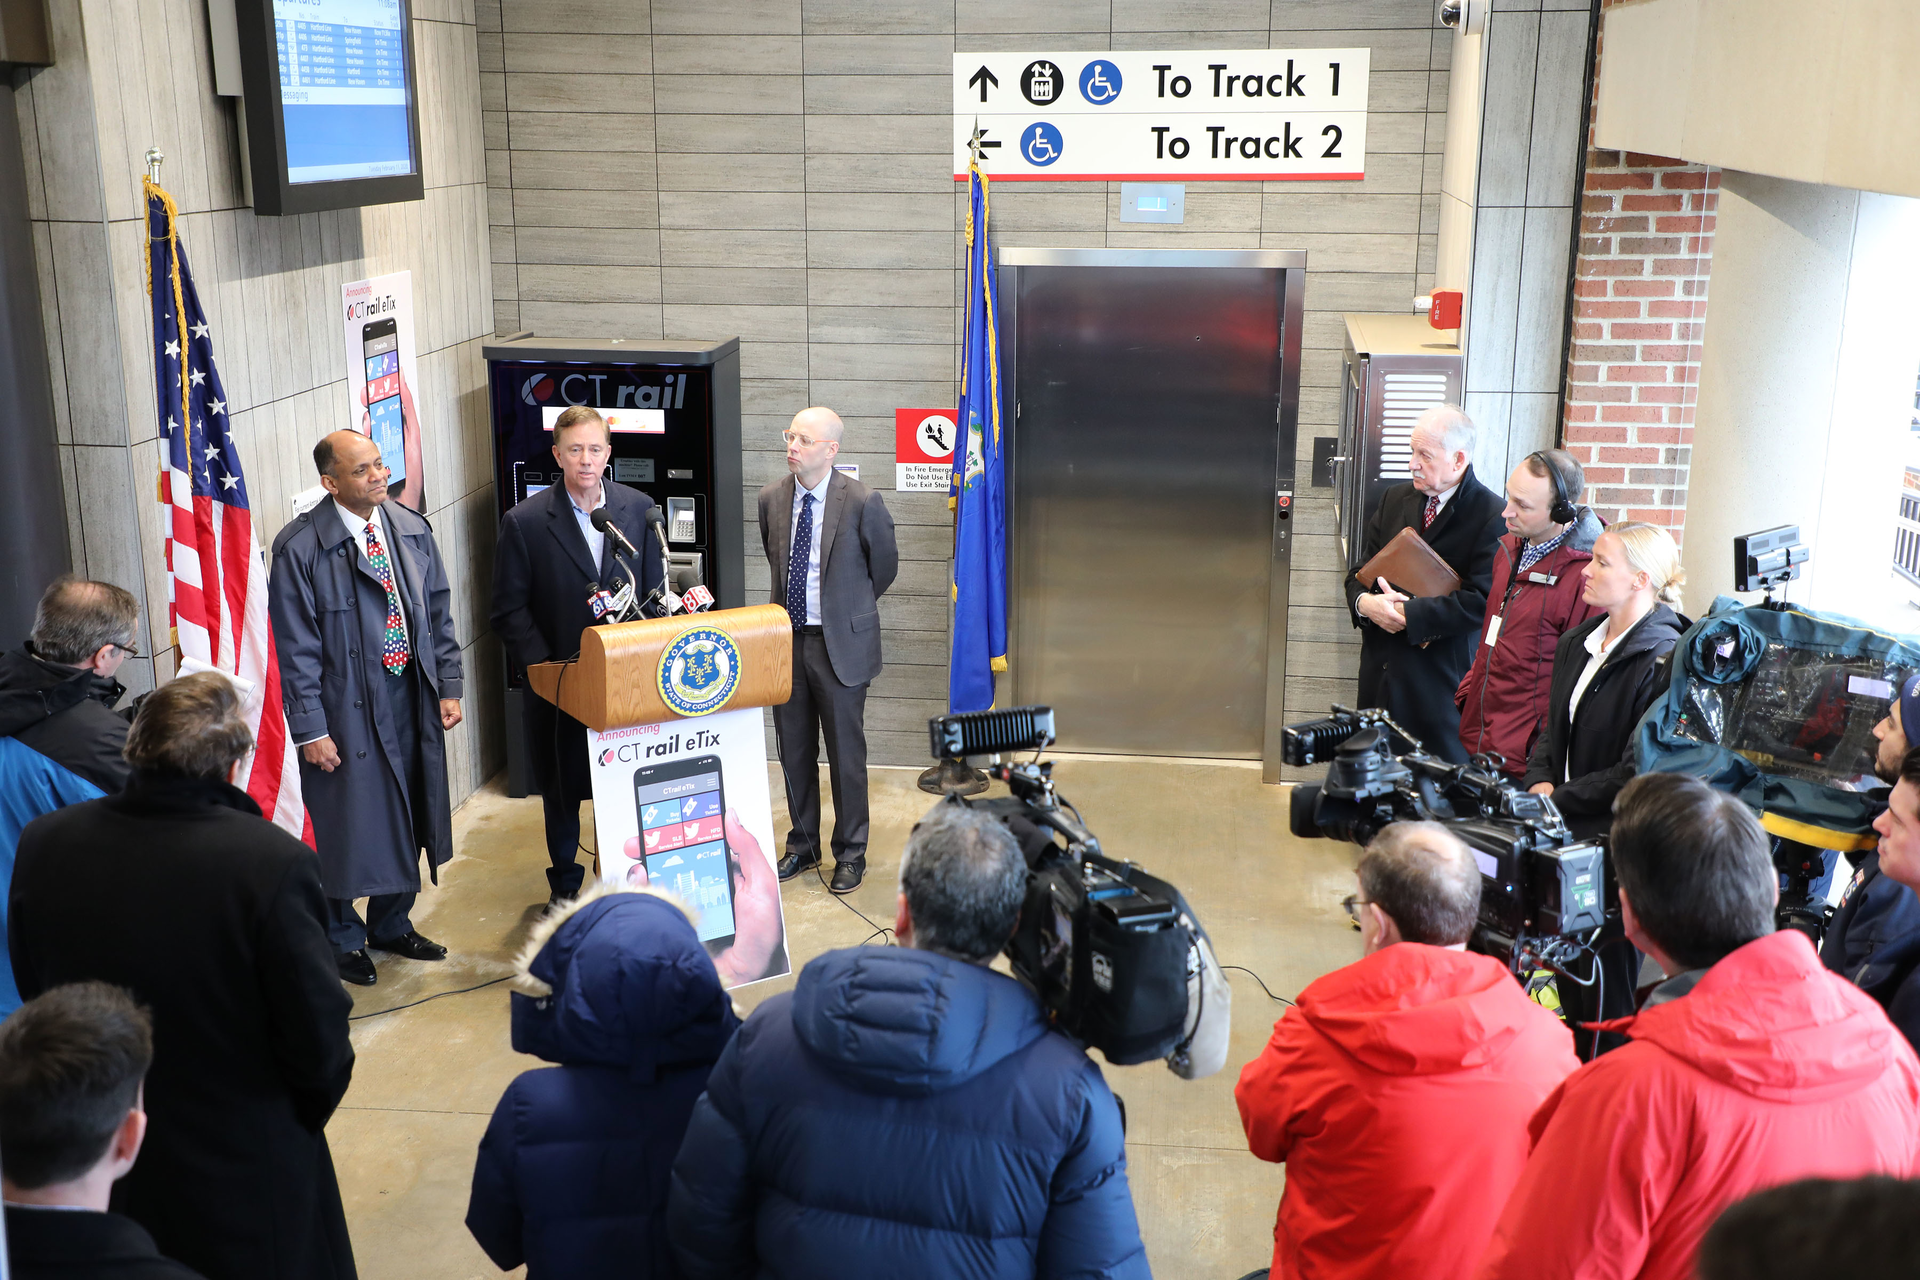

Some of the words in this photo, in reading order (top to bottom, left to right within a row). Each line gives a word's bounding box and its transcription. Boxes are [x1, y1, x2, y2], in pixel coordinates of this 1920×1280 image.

[1152, 64, 1192, 98] To
[1208, 60, 1306, 98] Track
[1330, 62, 1340, 96] 1
[281, 89, 308, 102] essaging
[1152, 126, 1190, 160] To
[1206, 121, 1303, 160] Track
[1322, 124, 1343, 158] 2
[346, 284, 372, 298] Announcing
[355, 302, 364, 318] CT
[366, 296, 380, 316] rail
[382, 295, 396, 312] eTix
[560, 374, 608, 406] CT
[616, 374, 687, 409] rail
[588, 594, 598, 604] FOX
[684, 594, 697, 611] 8
[695, 587, 709, 602] 8
[592, 599, 604, 614] 61
[666, 633, 733, 666] GOVERNOR
[665, 682, 680, 704] STATE
[692, 670, 735, 710] CONNECTICUT
[596, 724, 660, 743] Announcing
[617, 742, 640, 763] CT
[645, 733, 679, 758] rail
[686, 729, 720, 751] eTix
